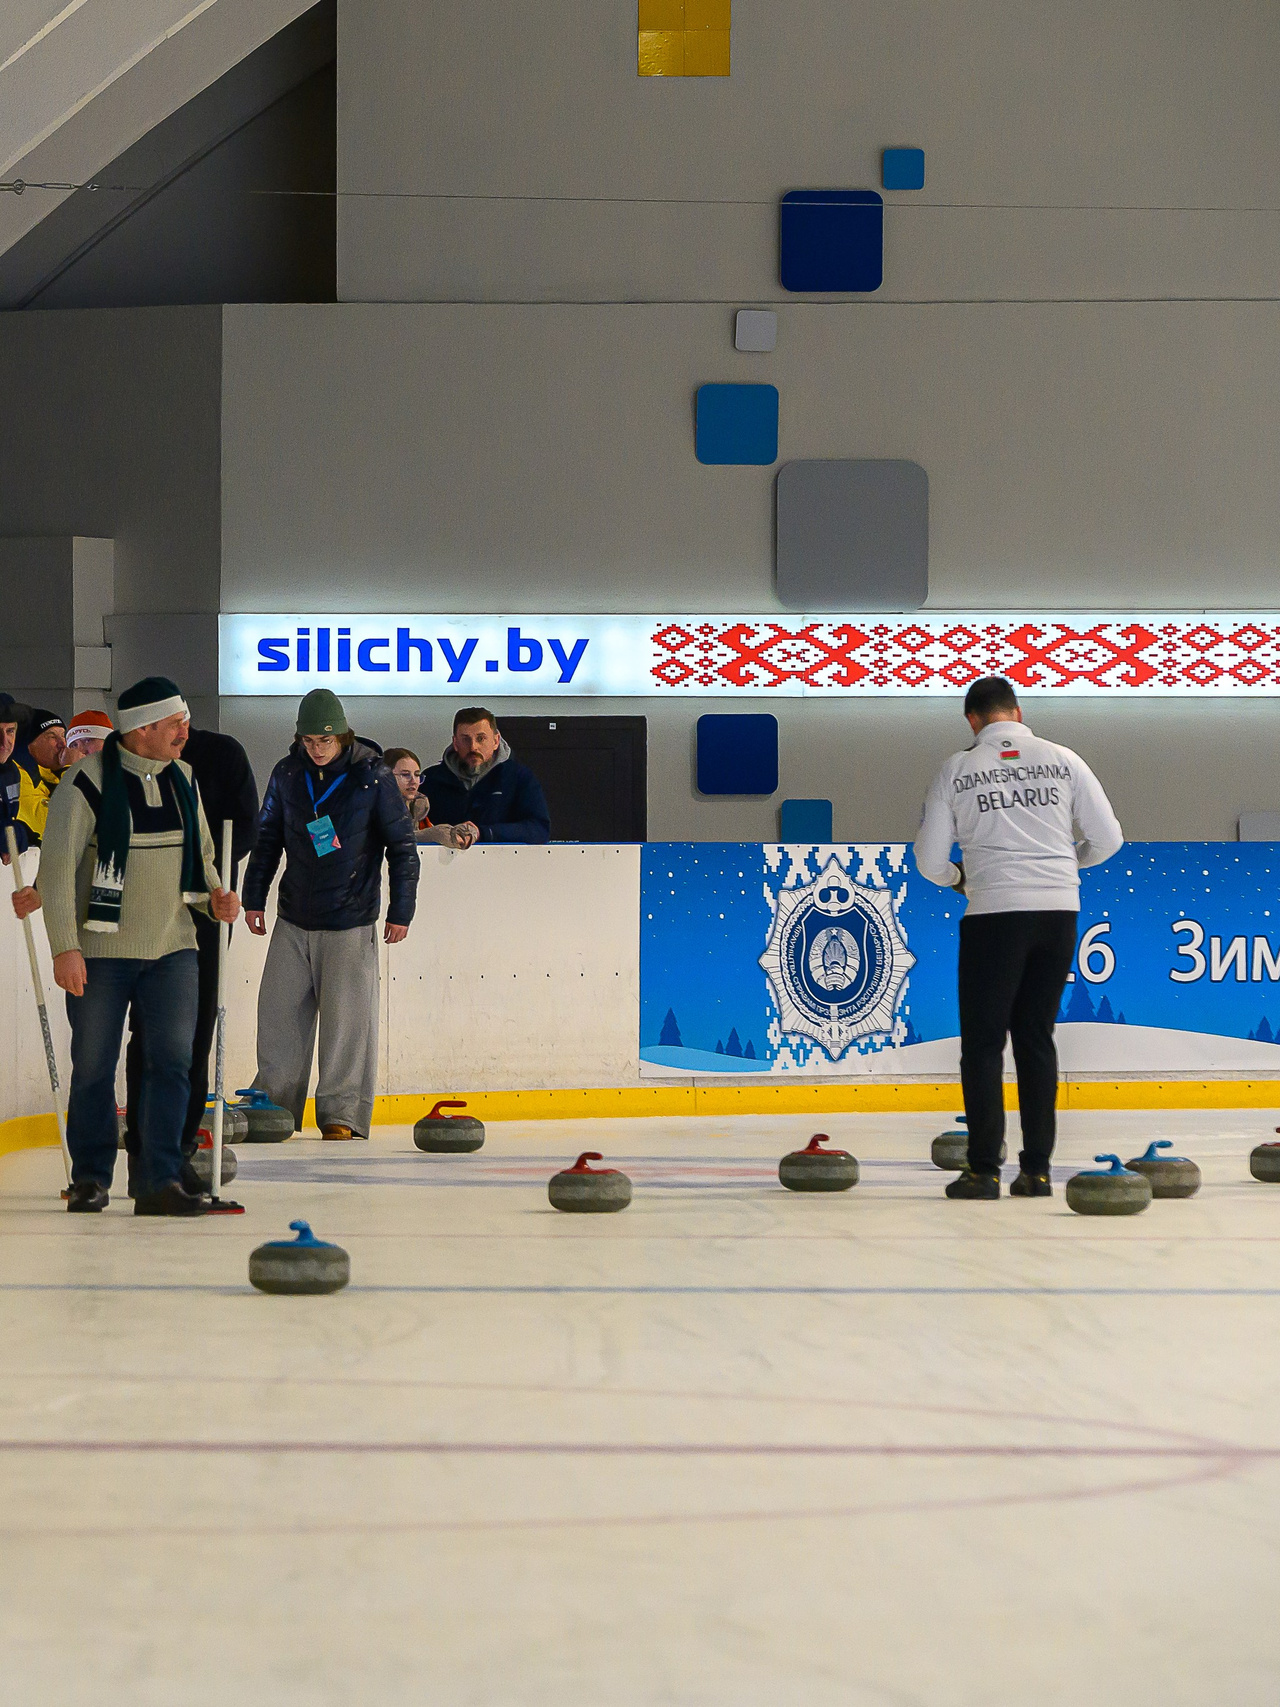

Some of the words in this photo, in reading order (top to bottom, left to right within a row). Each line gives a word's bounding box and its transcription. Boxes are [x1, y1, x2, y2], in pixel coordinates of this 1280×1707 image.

[257, 627, 590, 683] silichy.by
[953, 764, 1072, 794] DZIAMESHCHANKA
[976, 787, 1060, 813] BELARUS
[1066, 921, 1116, 983] 6
